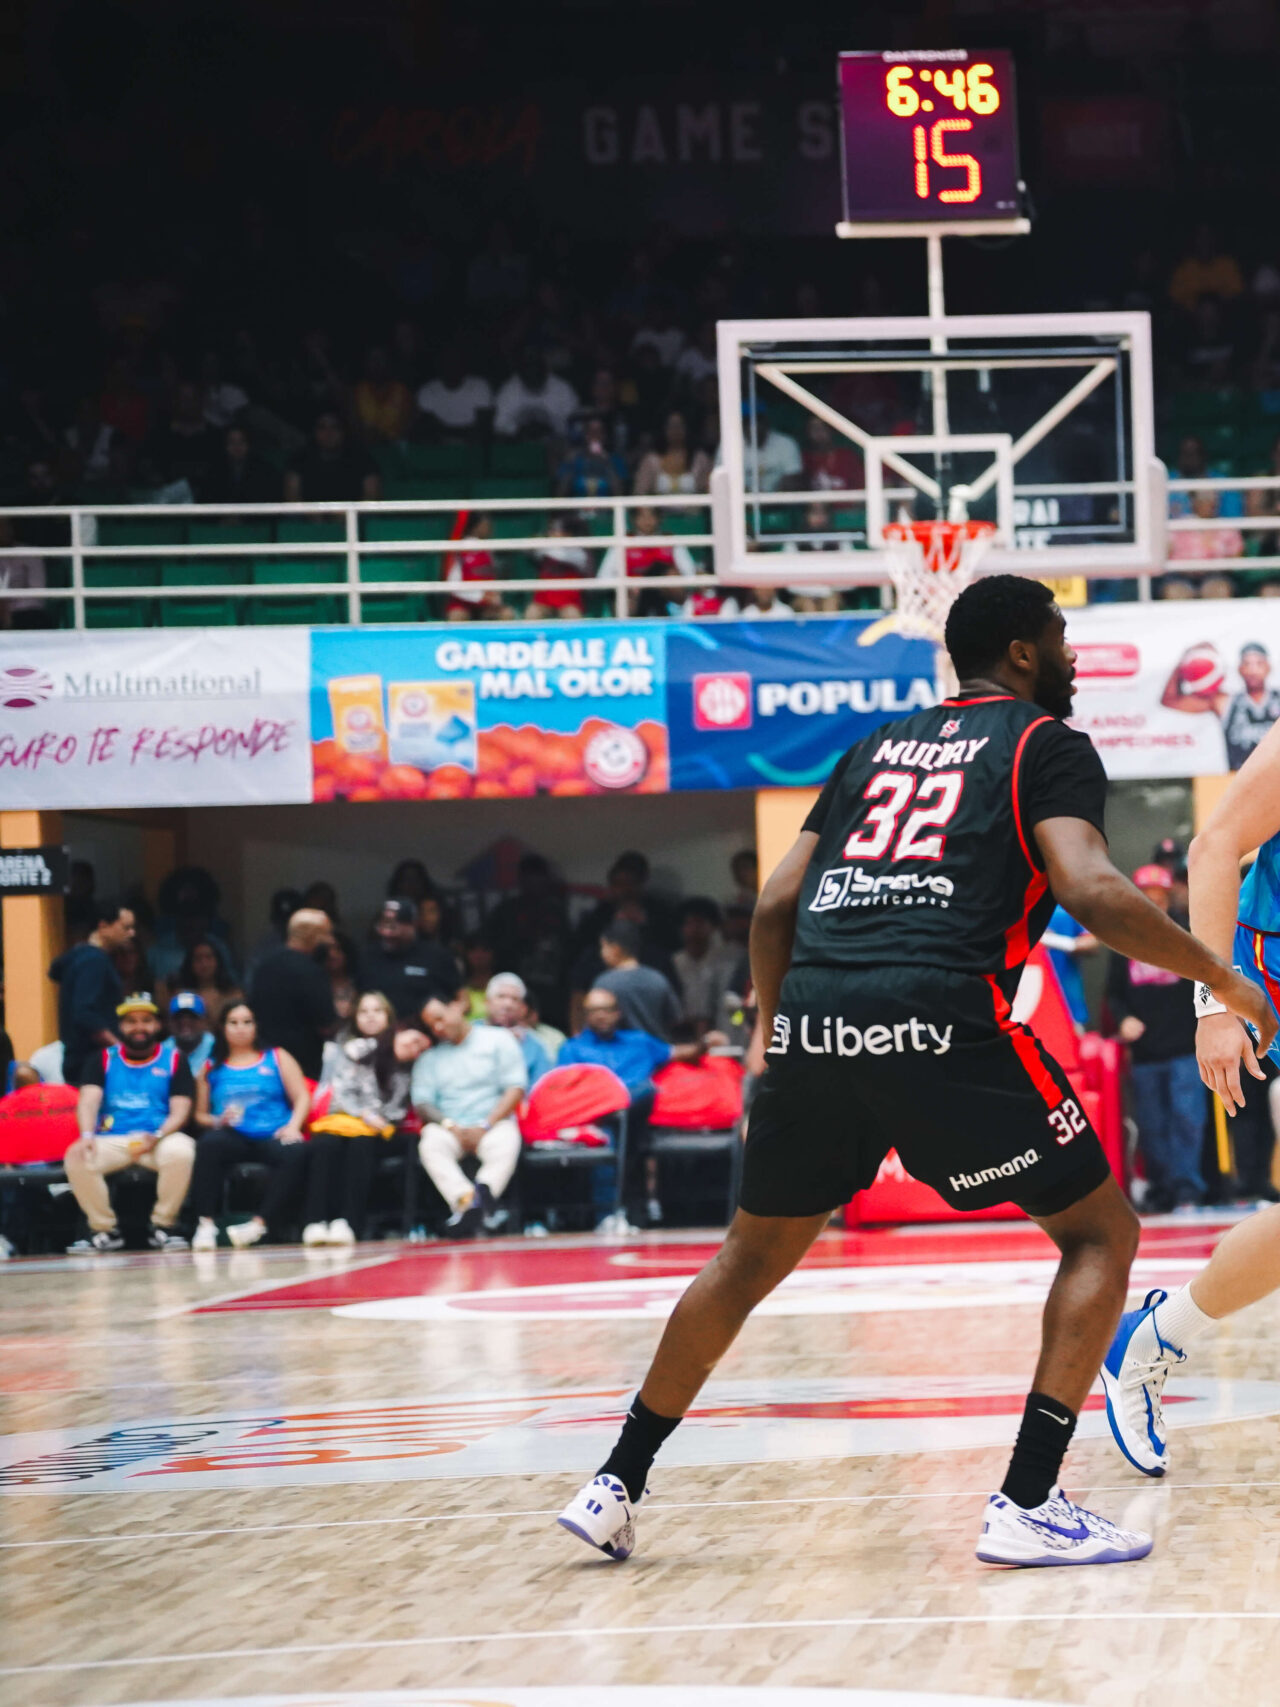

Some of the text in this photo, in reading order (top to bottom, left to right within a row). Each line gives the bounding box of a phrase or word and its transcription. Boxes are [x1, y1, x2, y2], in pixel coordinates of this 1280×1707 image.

[886, 63, 1000, 117] 6:46
[582, 101, 764, 166] GAME
[912, 118, 982, 204] 15
[611, 637, 654, 666] AL
[63, 668, 263, 698] Multinational
[479, 667, 654, 699] MAL OLOR
[130, 717, 297, 765] RESPONDE
[843, 770, 964, 862] 32
[800, 1014, 953, 1057] Liberty
[1048, 1098, 1087, 1146] 32
